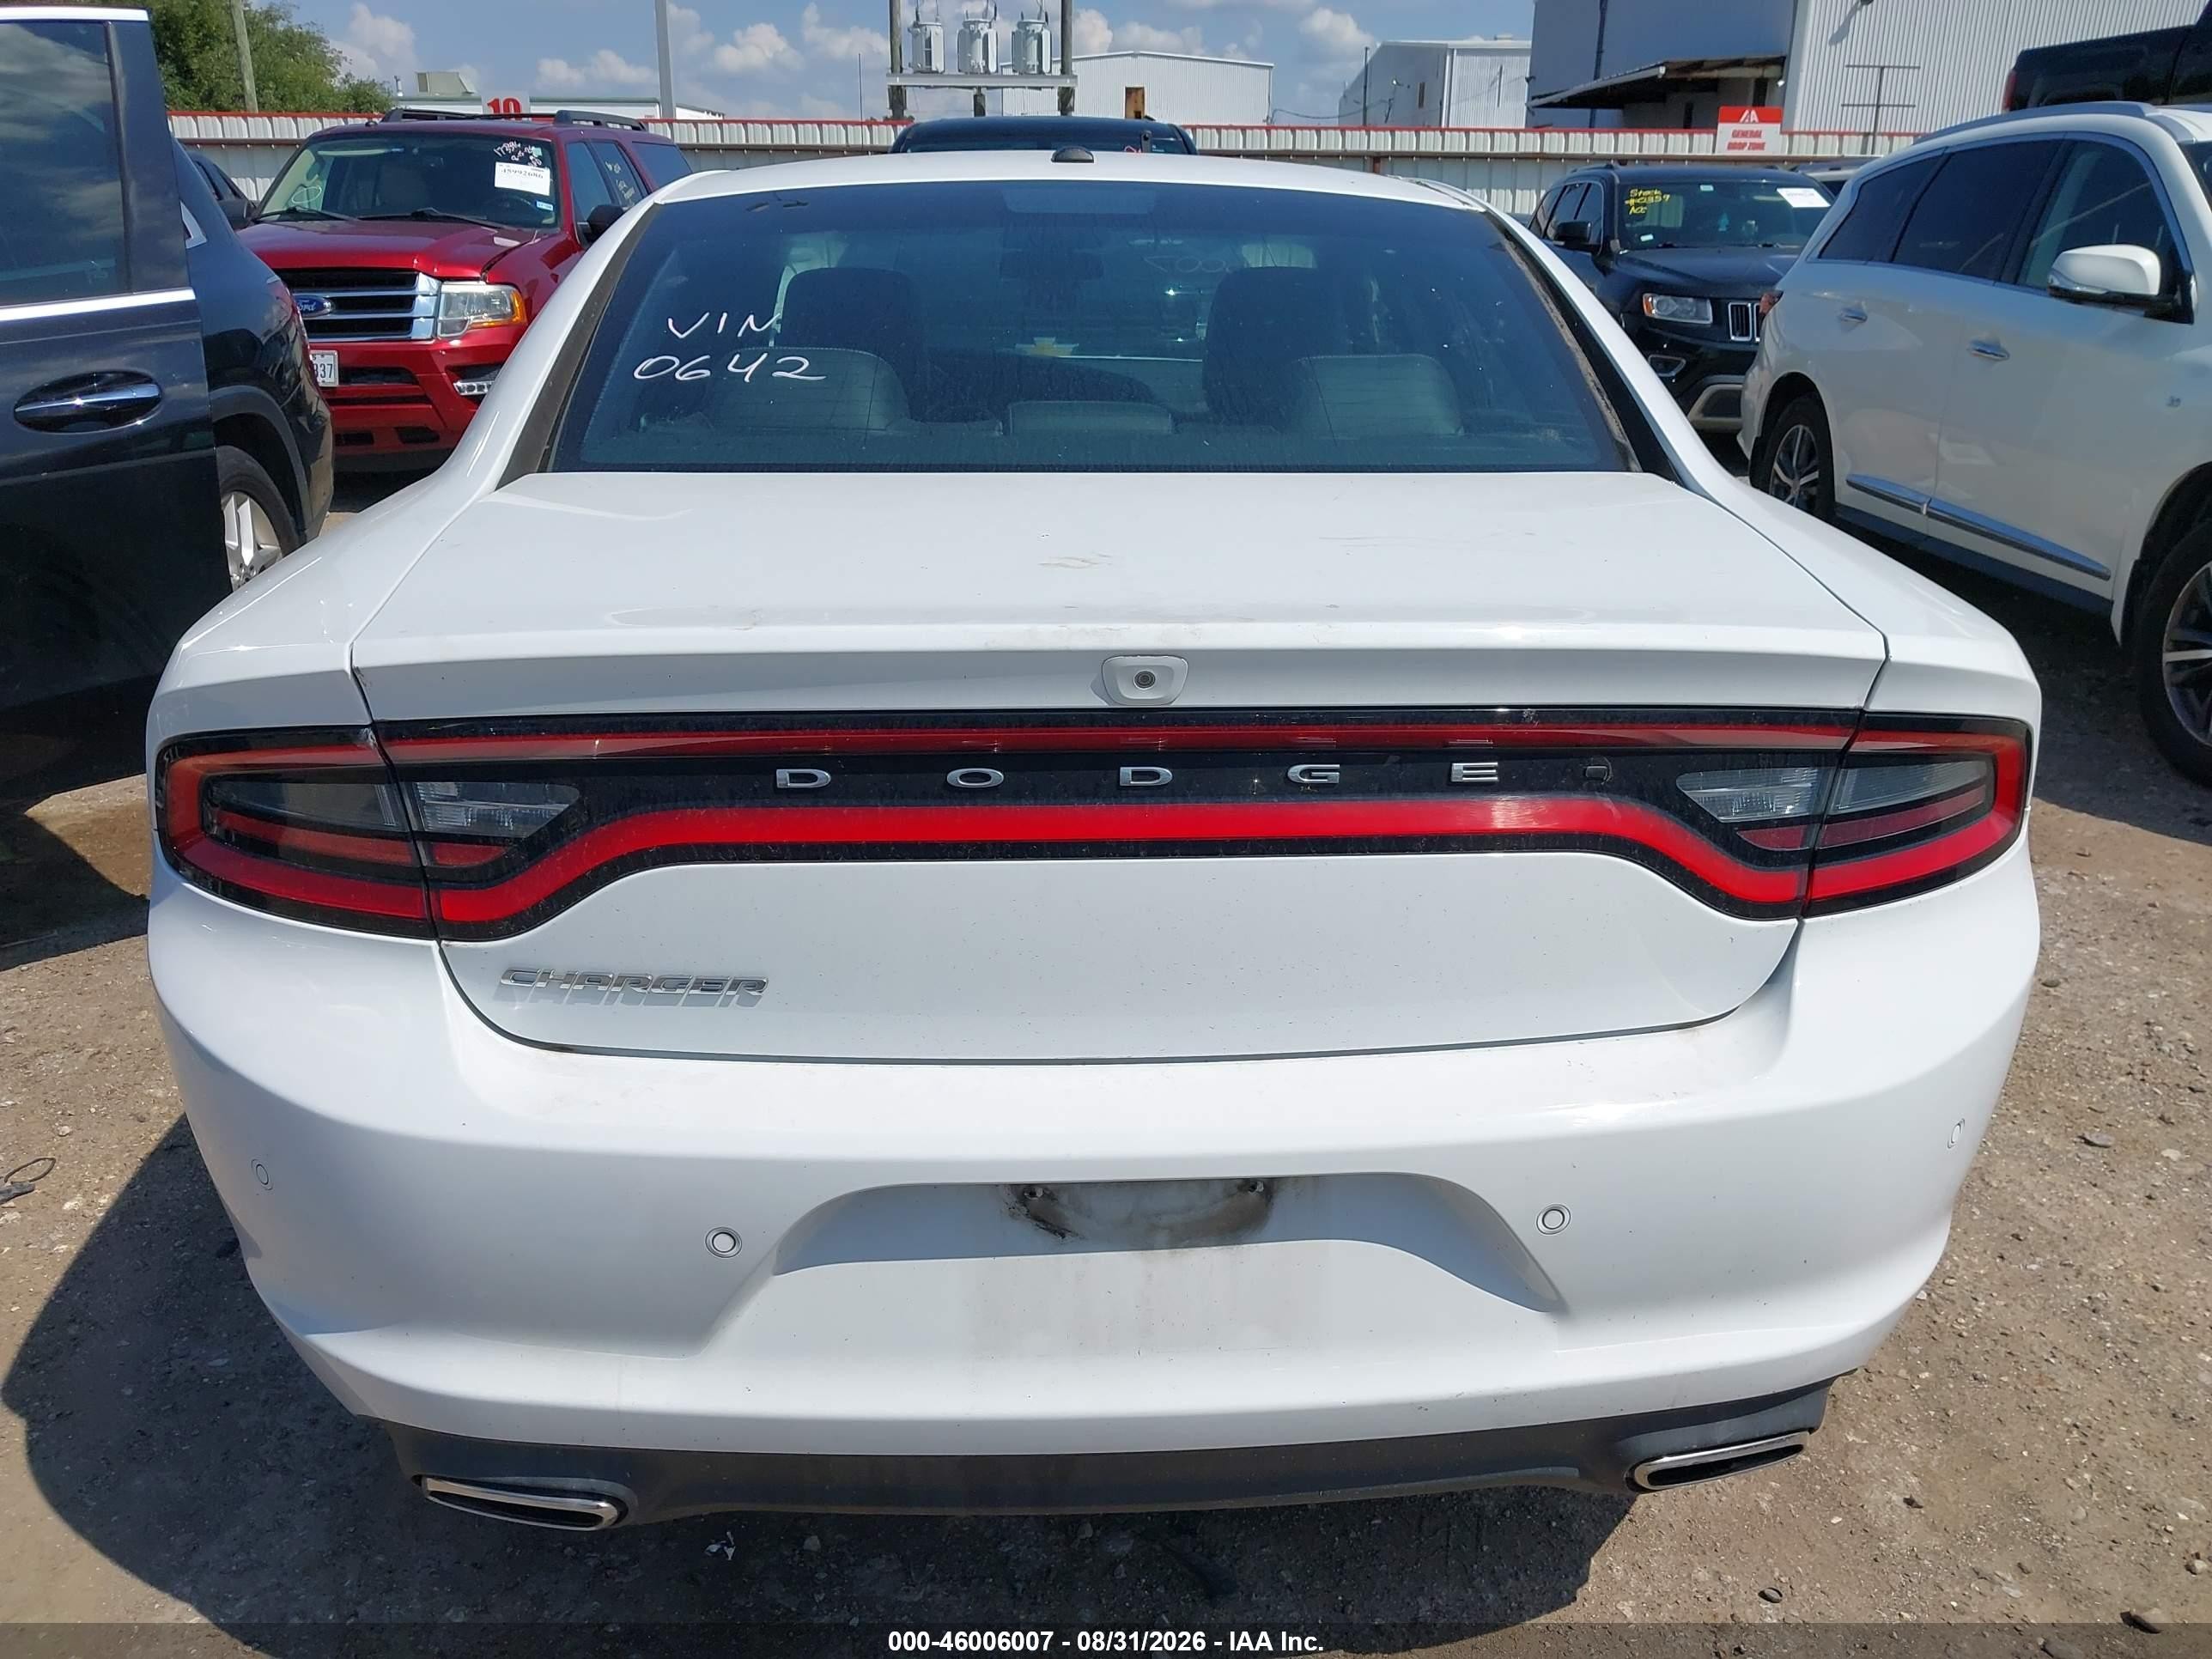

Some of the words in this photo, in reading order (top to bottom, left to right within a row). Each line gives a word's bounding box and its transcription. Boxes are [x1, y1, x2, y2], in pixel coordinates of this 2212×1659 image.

[1727, 142, 1747, 150] DROP
[1747, 142, 1765, 150] ZONE
[1731, 130, 1762, 138] GENERAL
[668, 312, 781, 338] VIN
[634, 352, 827, 383] 0642
[776, 761, 1498, 788] DODGE
[501, 968, 769, 996] CHARGER
